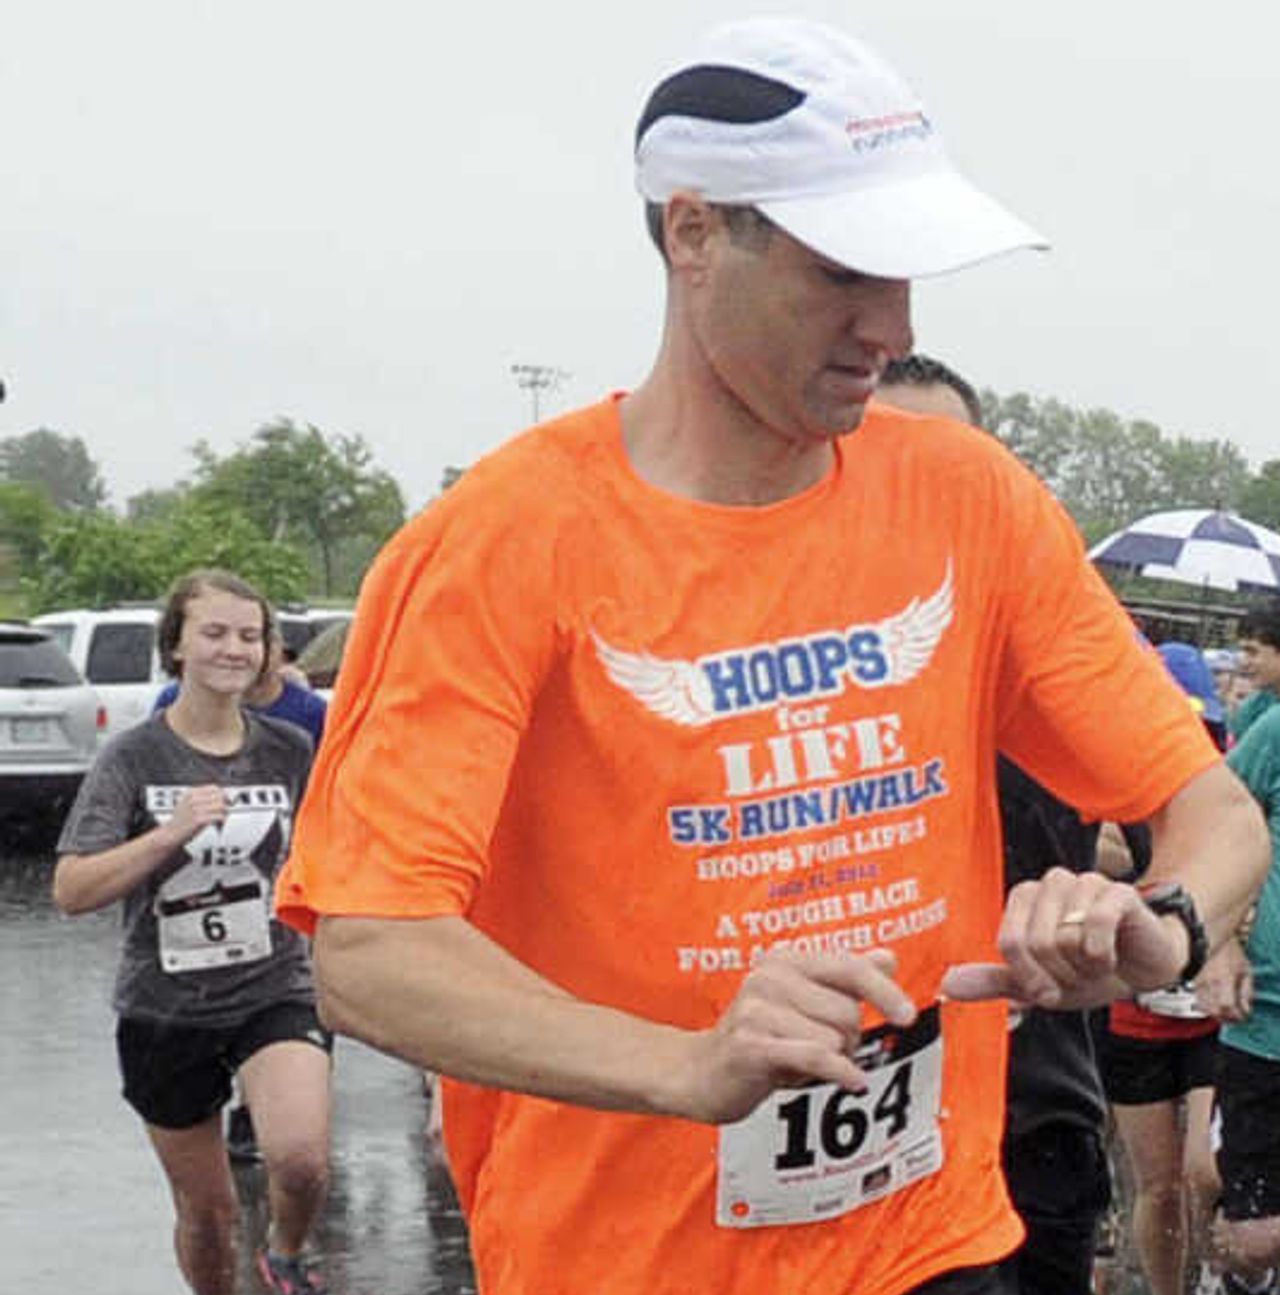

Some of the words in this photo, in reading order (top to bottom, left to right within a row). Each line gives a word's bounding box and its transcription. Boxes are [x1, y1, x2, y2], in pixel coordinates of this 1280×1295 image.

[703, 630, 888, 712] HOOPS
[776, 705, 830, 730] for
[718, 713, 906, 797] LIFE
[671, 807, 731, 843] 5K
[739, 759, 944, 838] RUN/WALK
[696, 847, 794, 881] HOOPS
[797, 835, 850, 868] FOR
[202, 910, 227, 942] 6
[715, 914, 739, 939] A
[742, 896, 845, 937] TOUGH
[847, 878, 920, 914] RACE
[677, 946, 744, 973] FOR
[775, 1058, 914, 1171] 164
